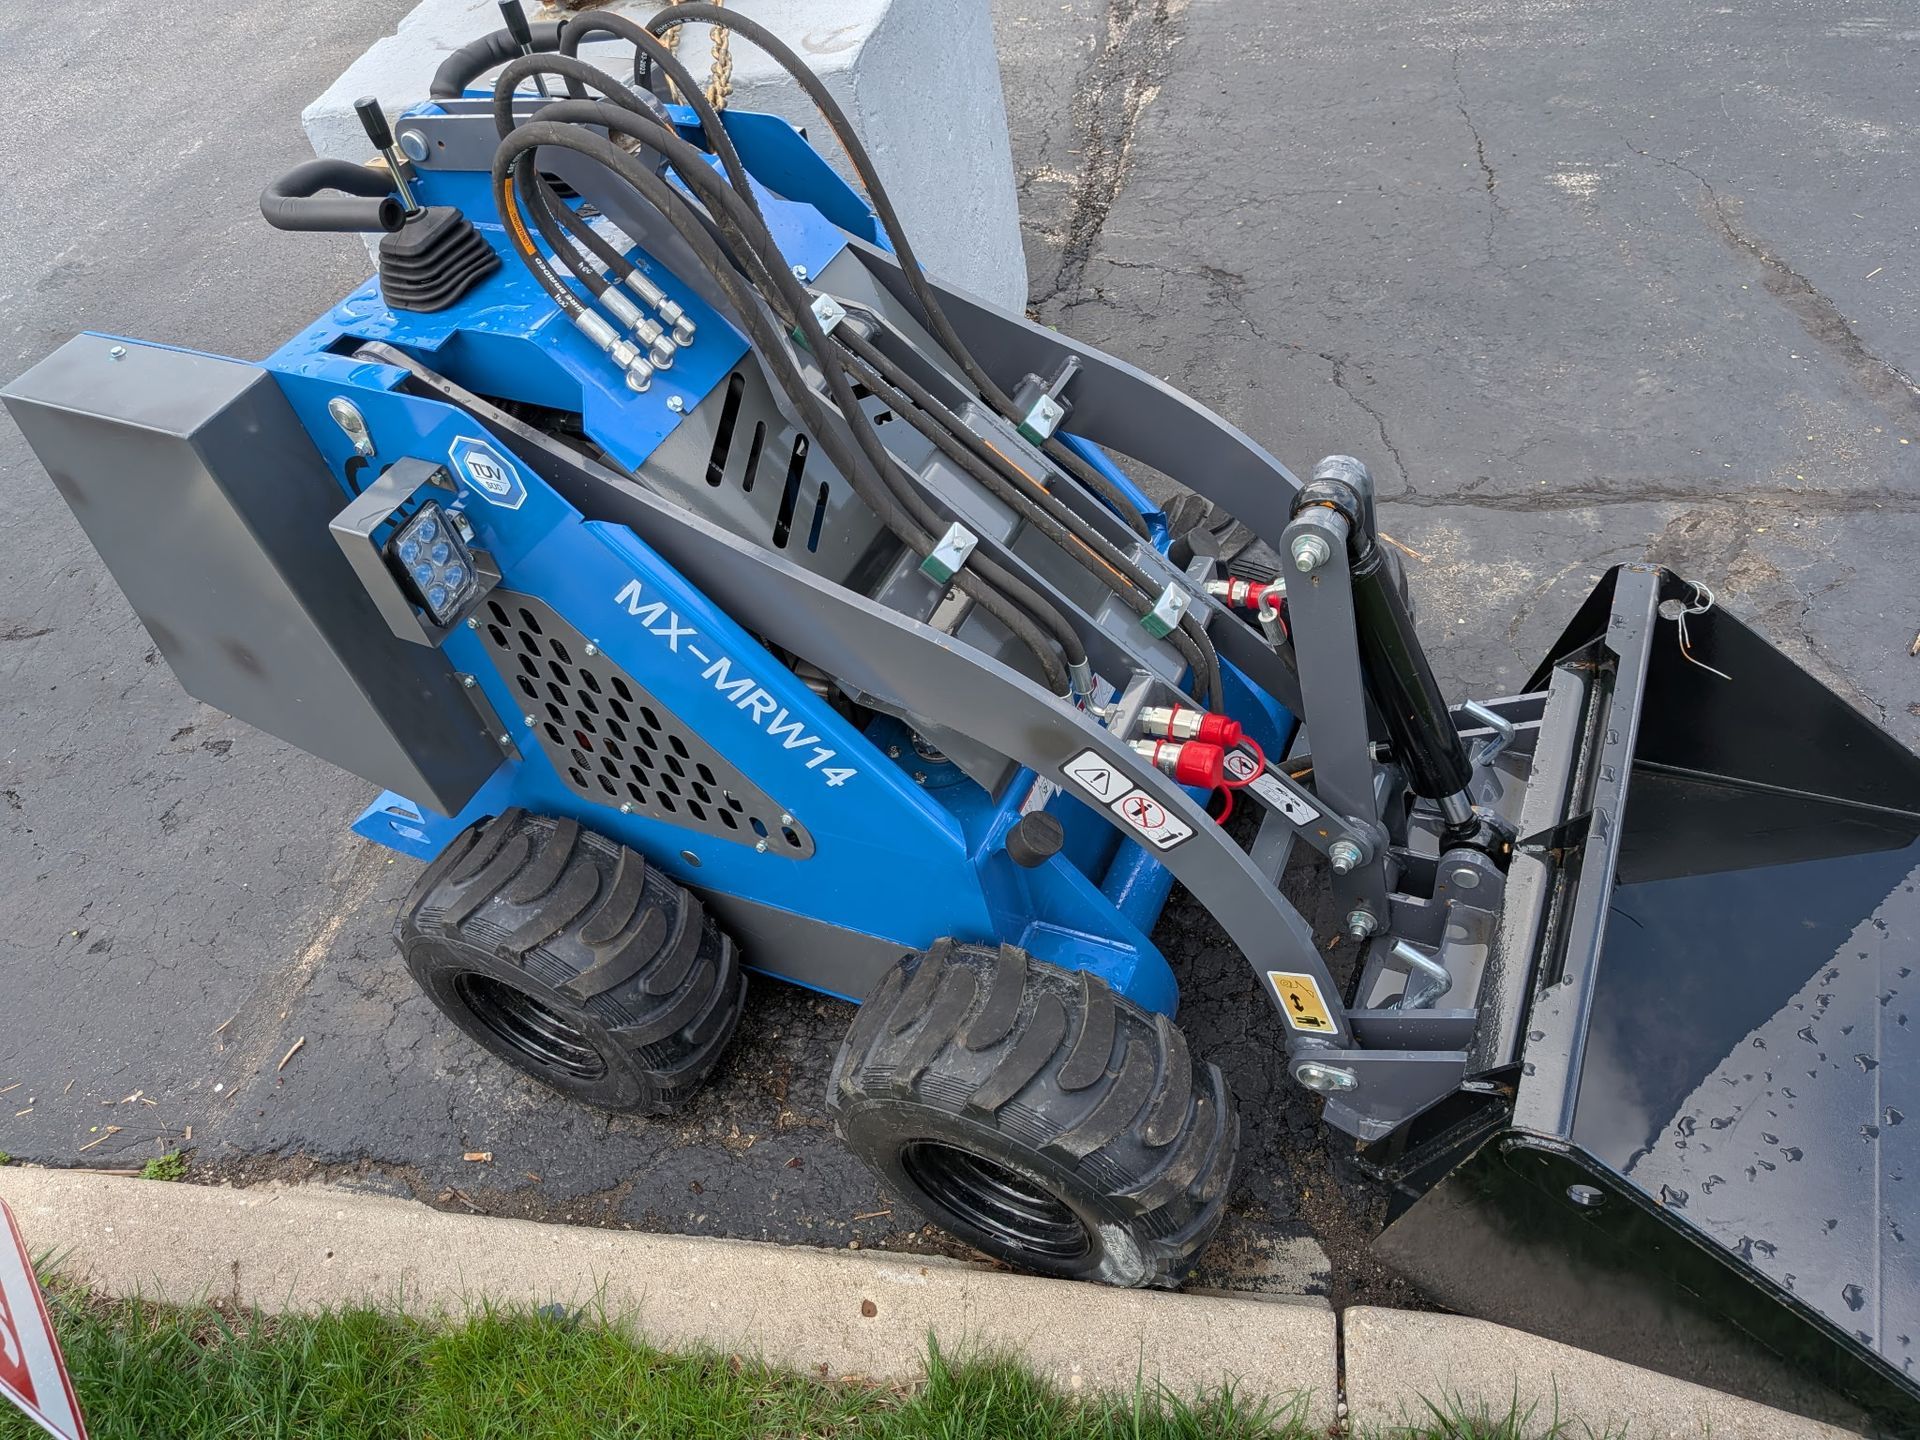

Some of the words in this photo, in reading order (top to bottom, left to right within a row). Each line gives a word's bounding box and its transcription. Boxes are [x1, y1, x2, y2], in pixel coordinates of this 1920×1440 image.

[535, 257, 567, 295] BRAIDED
[468, 461, 502, 481] TÜV
[614, 579, 858, 788] MX-MRW14
